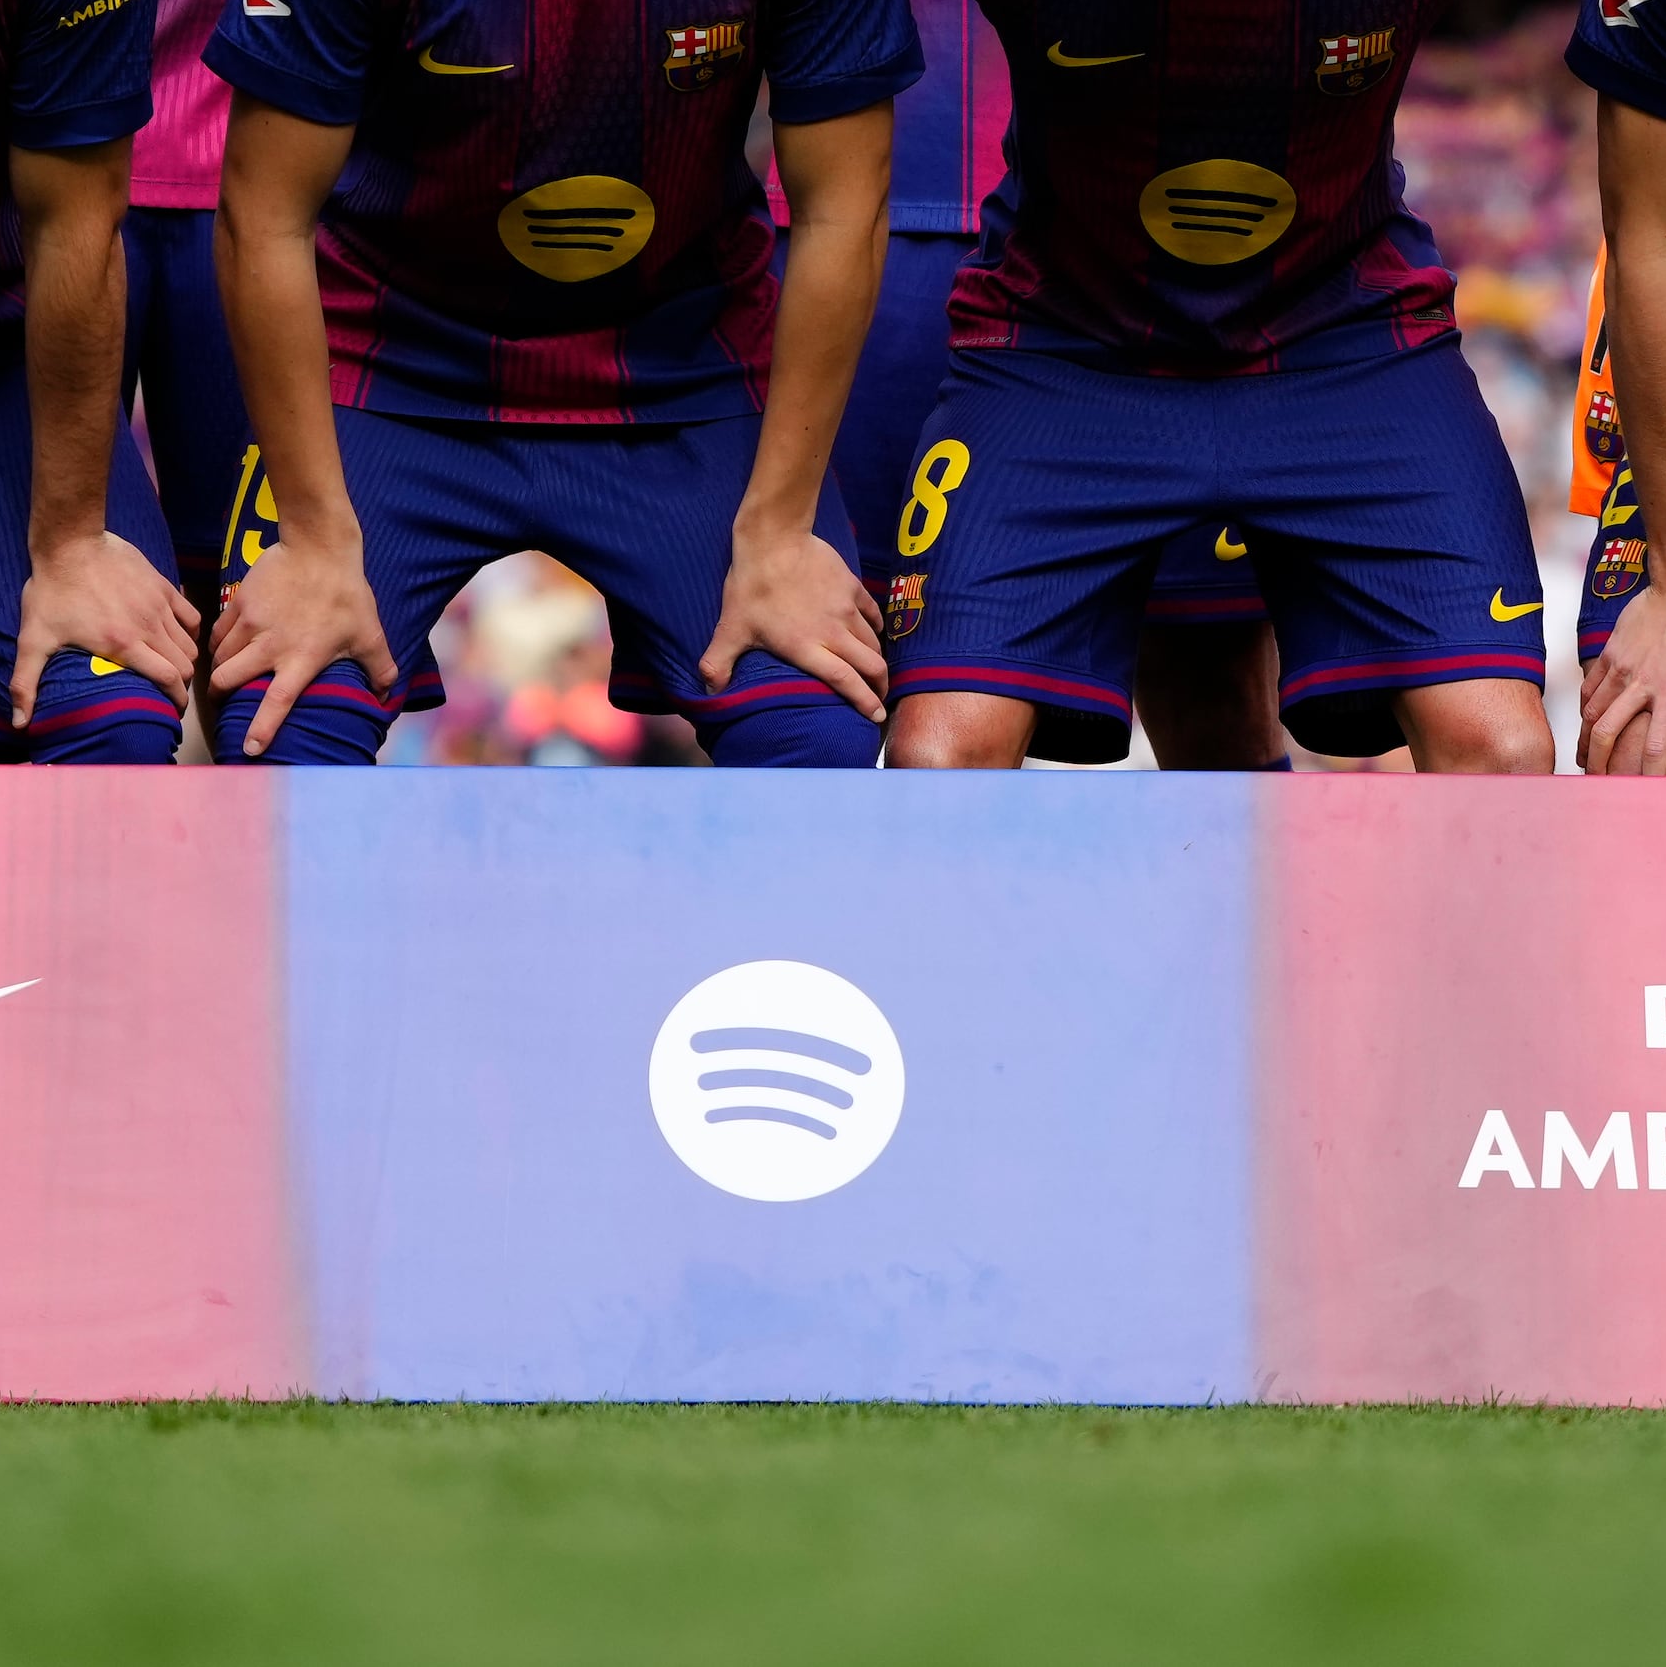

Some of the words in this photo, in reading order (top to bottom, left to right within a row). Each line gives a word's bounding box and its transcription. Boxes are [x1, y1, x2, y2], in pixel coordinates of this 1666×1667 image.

[1597, 421, 1618, 434] FCB
[897, 438, 971, 557] 8
[1606, 561, 1627, 572] FCB
